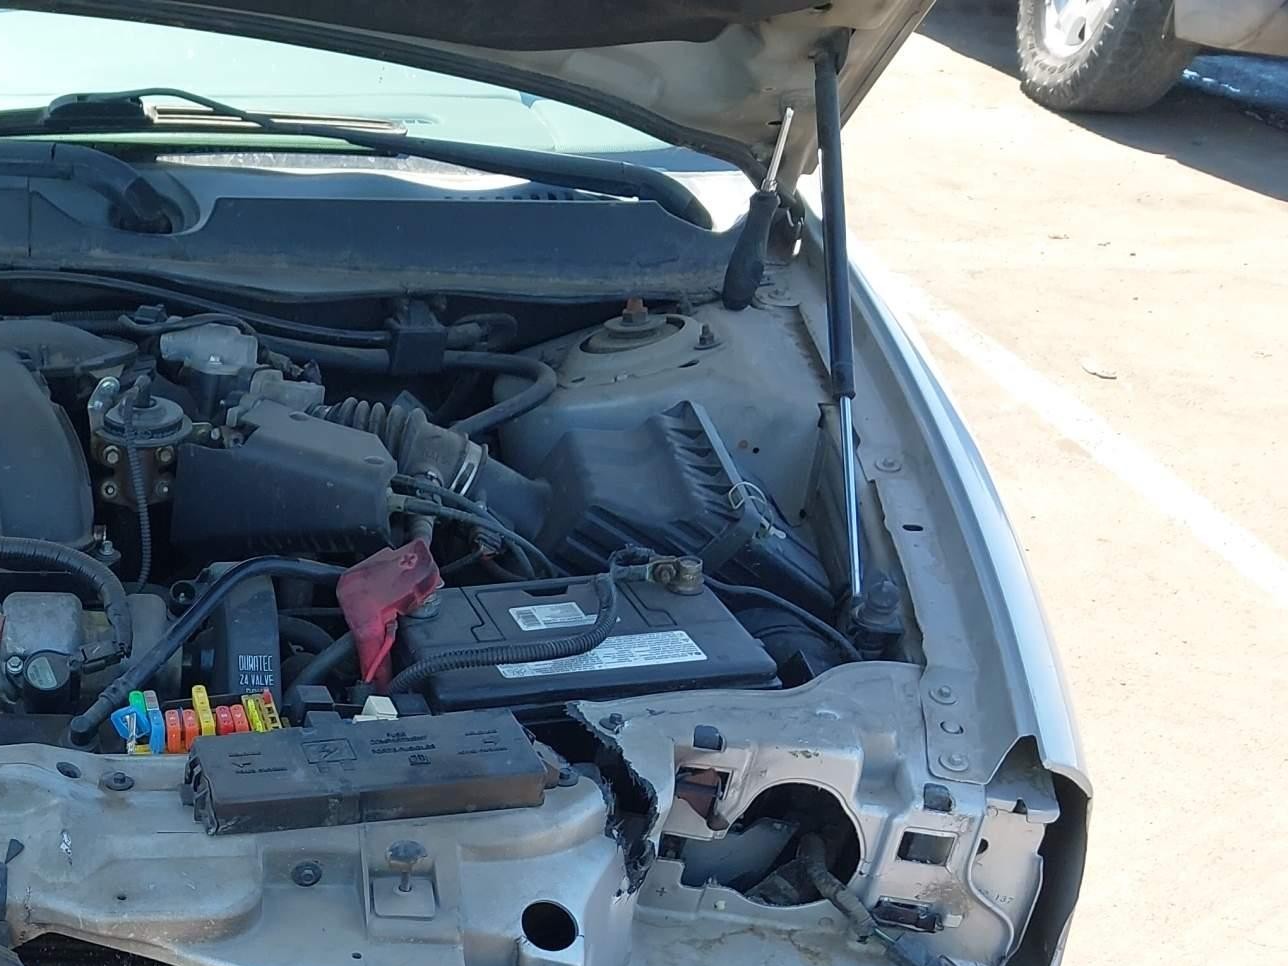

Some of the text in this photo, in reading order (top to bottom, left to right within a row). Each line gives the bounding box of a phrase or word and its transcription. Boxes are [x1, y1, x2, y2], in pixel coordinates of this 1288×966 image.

[238, 654, 273, 672] DURATEC
[239, 673, 275, 687] 24 VALVE
